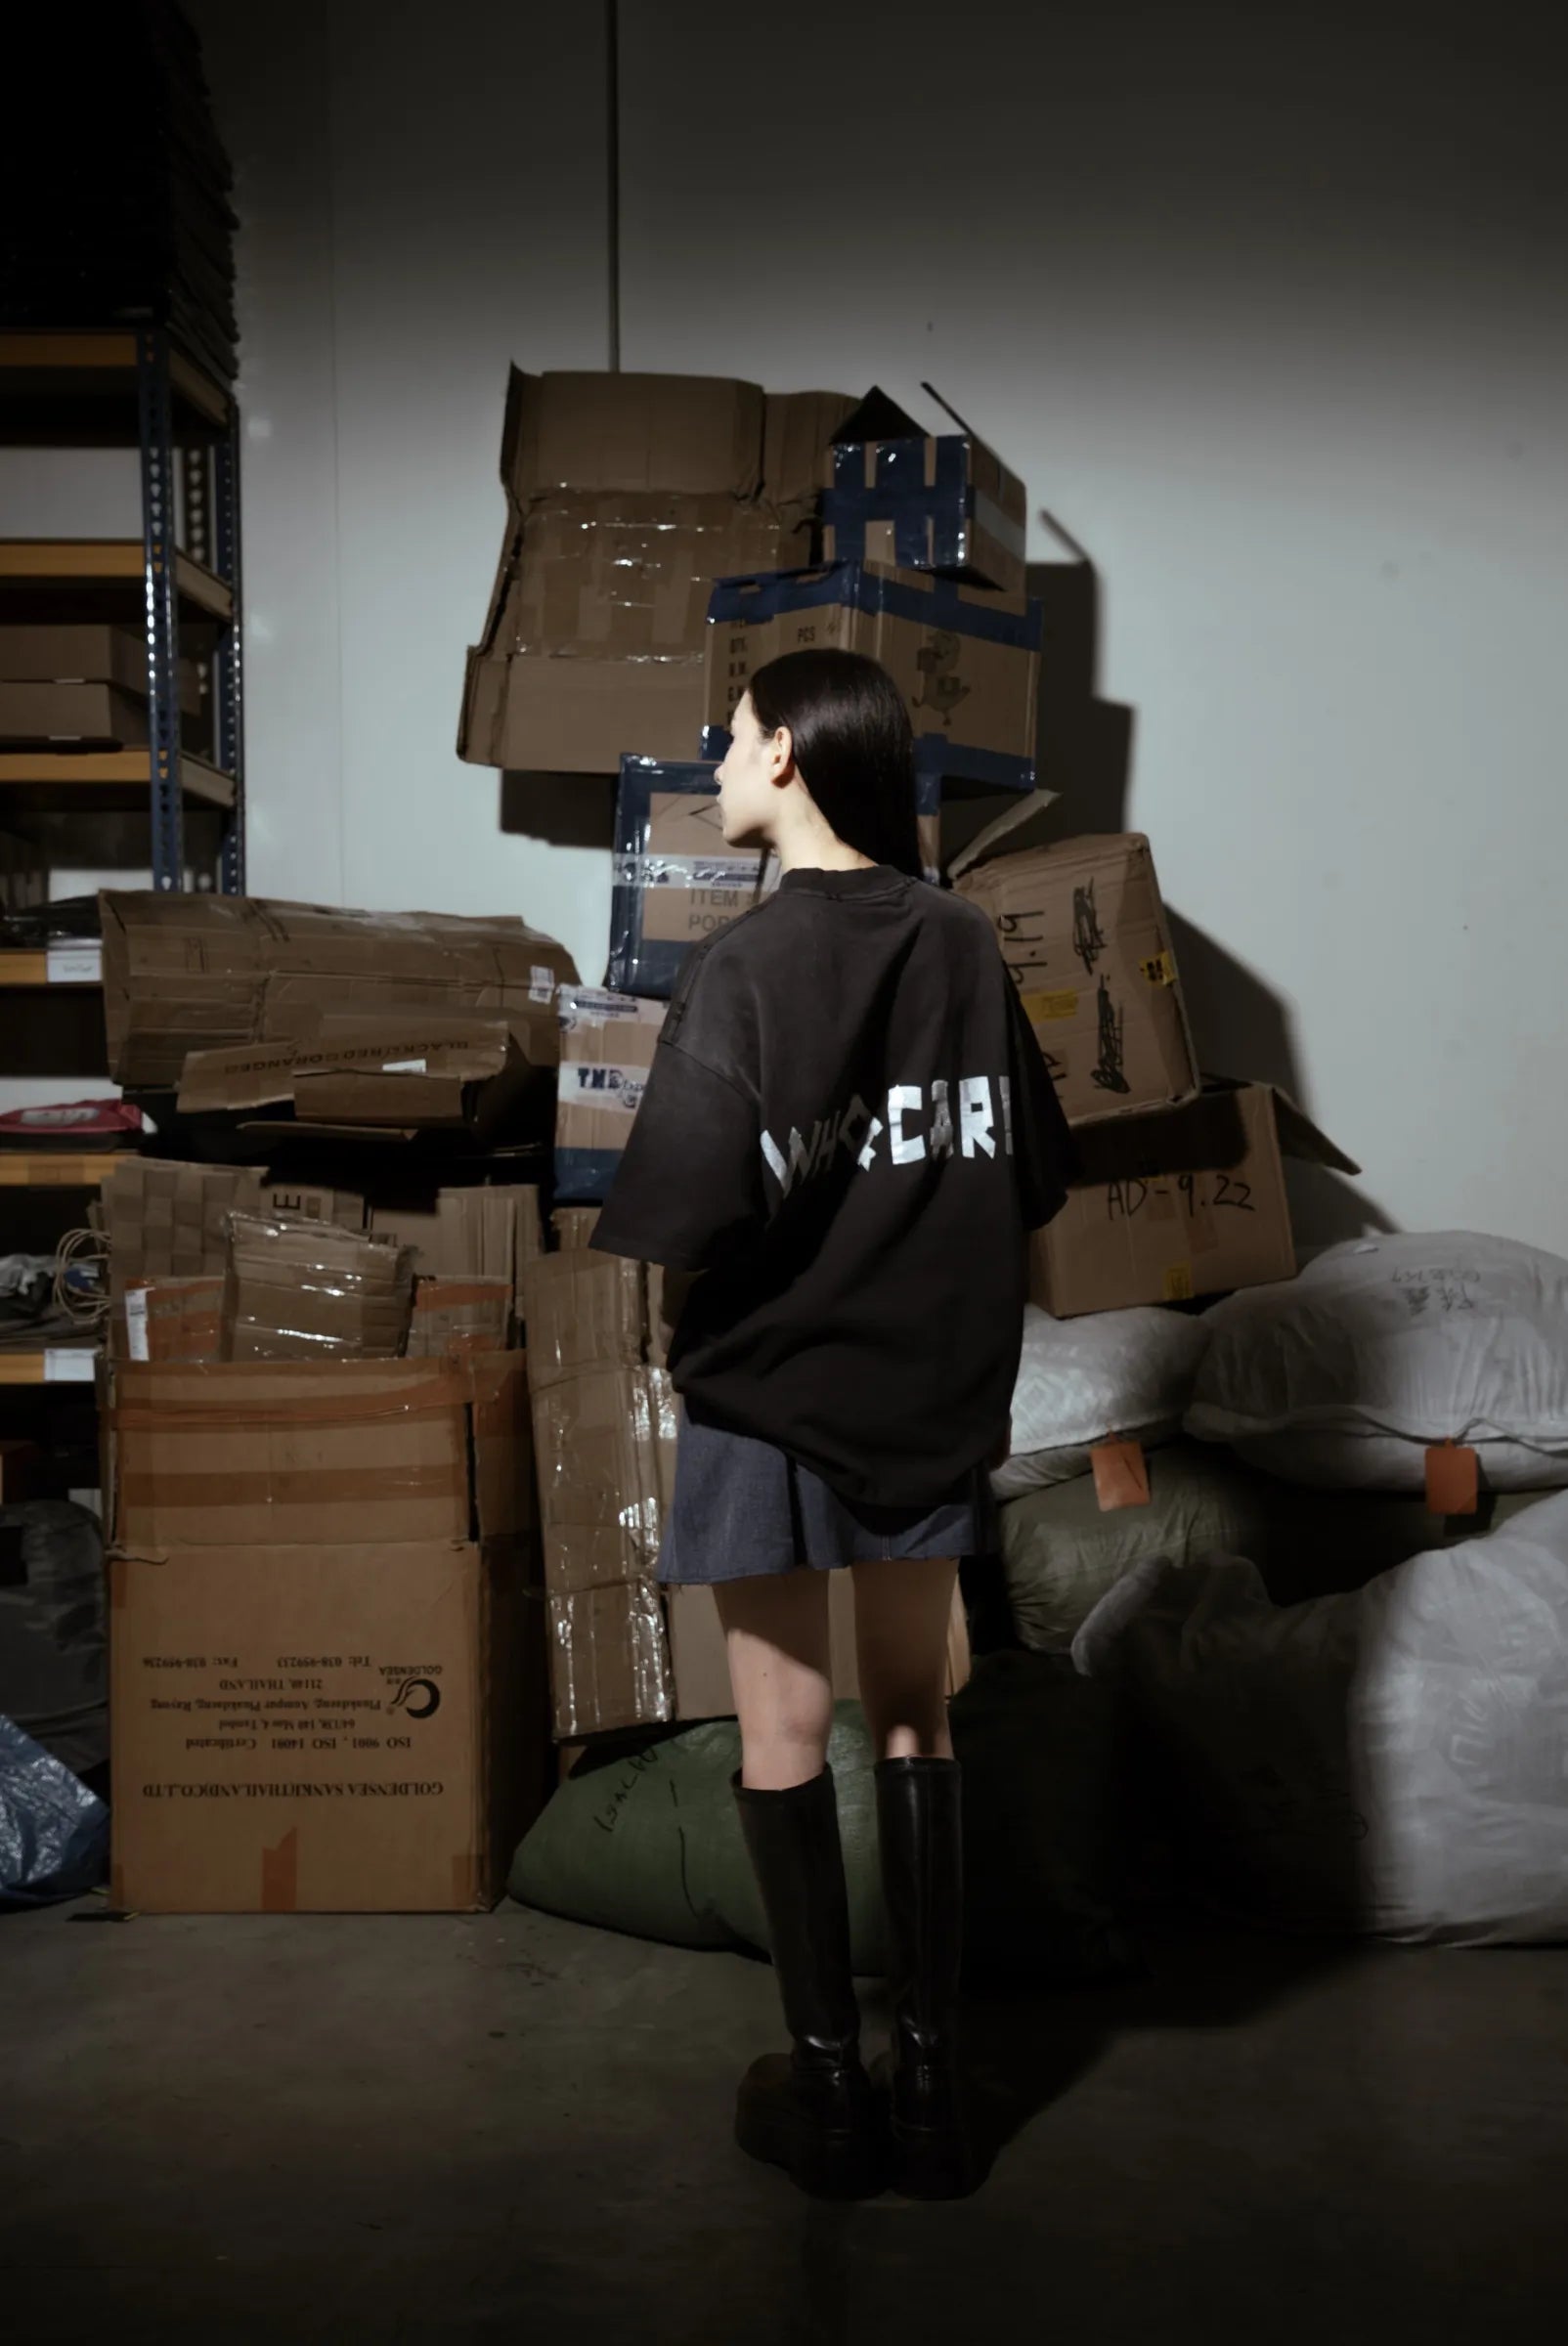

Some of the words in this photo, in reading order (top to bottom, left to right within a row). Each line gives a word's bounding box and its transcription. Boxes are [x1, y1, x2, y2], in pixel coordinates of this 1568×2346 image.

[690, 889, 739, 907] ITEM
[219, 1679, 283, 1690] THAILAND
[313, 1737, 336, 1749] ISO
[387, 1737, 411, 1748] ISO
[348, 1782, 444, 1797] GOLDENSEA
